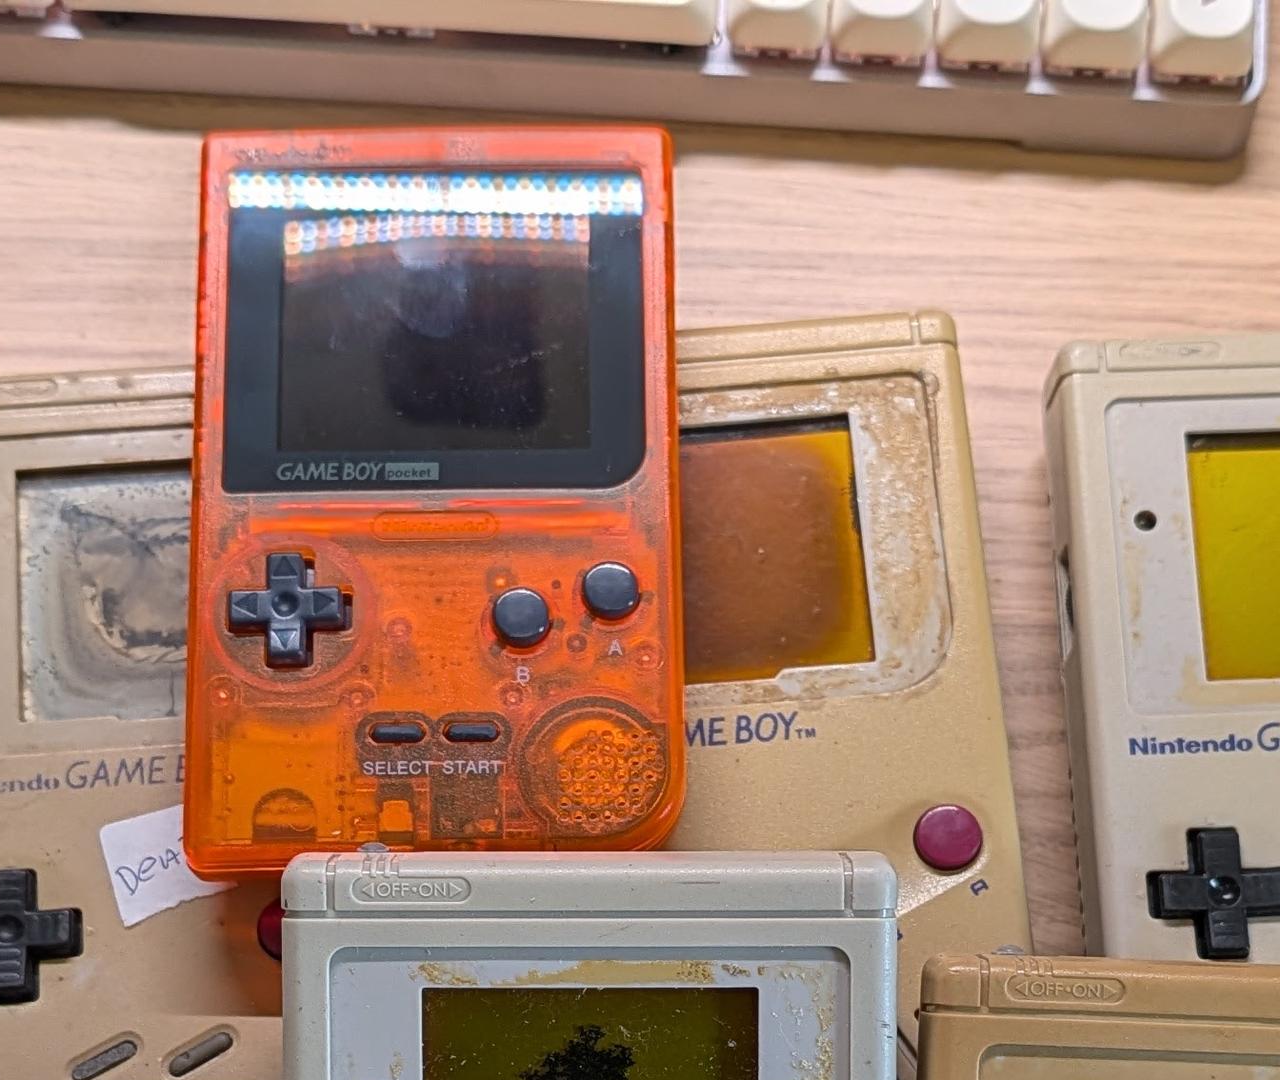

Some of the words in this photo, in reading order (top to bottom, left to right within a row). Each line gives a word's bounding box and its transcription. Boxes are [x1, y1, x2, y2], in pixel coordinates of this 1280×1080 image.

[277, 462, 339, 481] GAME
[341, 462, 384, 481] BOY
[385, 466, 432, 481] pocket
[607, 639, 624, 656] A
[685, 715, 727, 747] ME
[735, 710, 798, 745] BOY
[1129, 733, 1254, 756] Nintendo
[65, 755, 167, 791] GAME
[363, 759, 431, 776] SELECT
[442, 759, 504, 776] START
